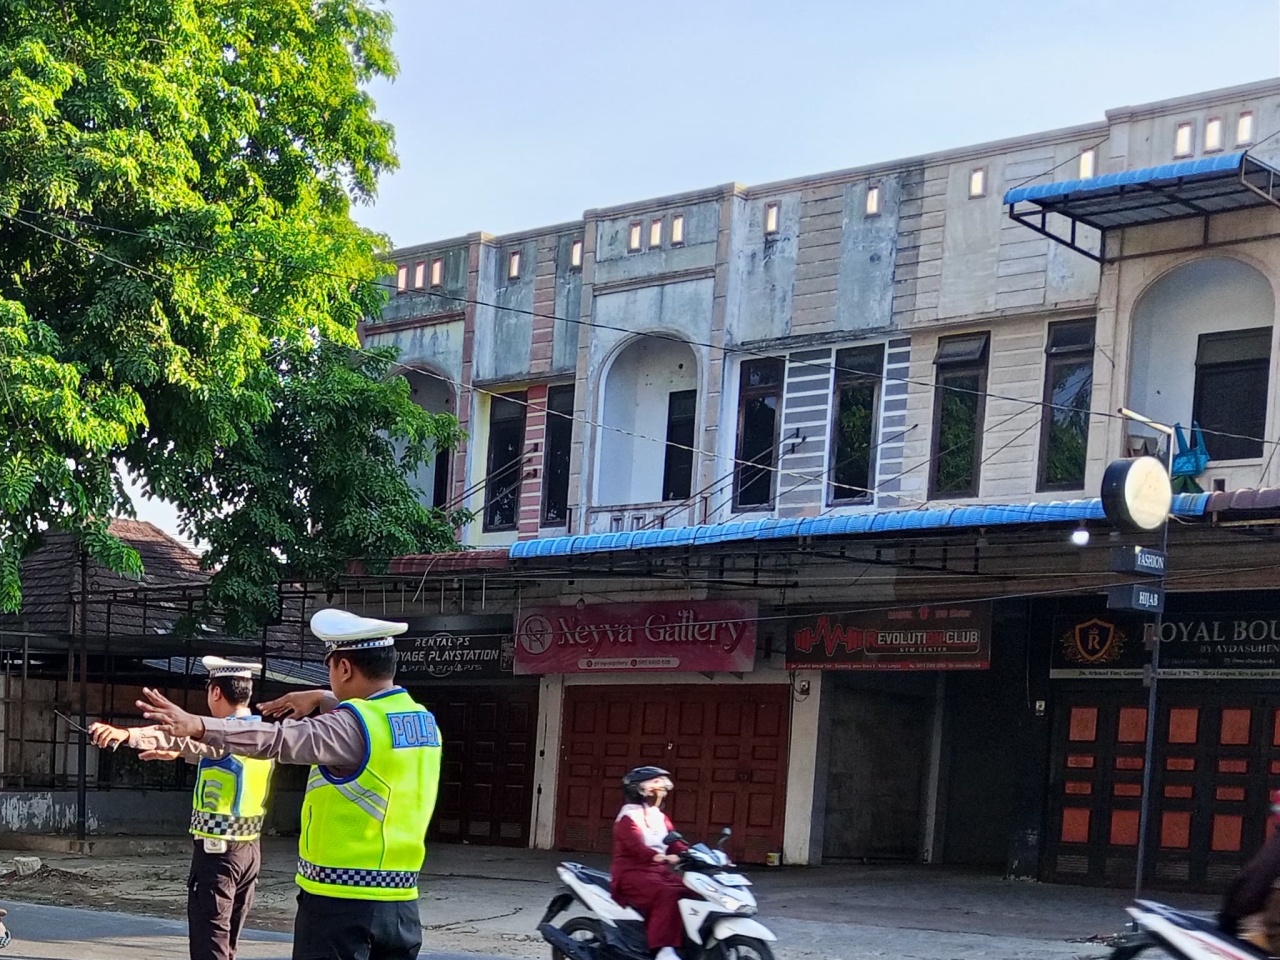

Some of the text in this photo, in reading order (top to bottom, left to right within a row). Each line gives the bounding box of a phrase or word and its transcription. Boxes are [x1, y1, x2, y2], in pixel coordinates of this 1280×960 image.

[1137, 553, 1164, 569] FASHION
[1139, 591, 1159, 607] HIJAB
[645, 609, 743, 650] Gallery
[945, 631, 978, 644] CLUB
[415, 637, 470, 647] RENTAL PS
[1088, 634, 1100, 650] R
[428, 649, 499, 661] PLAYSTATION
